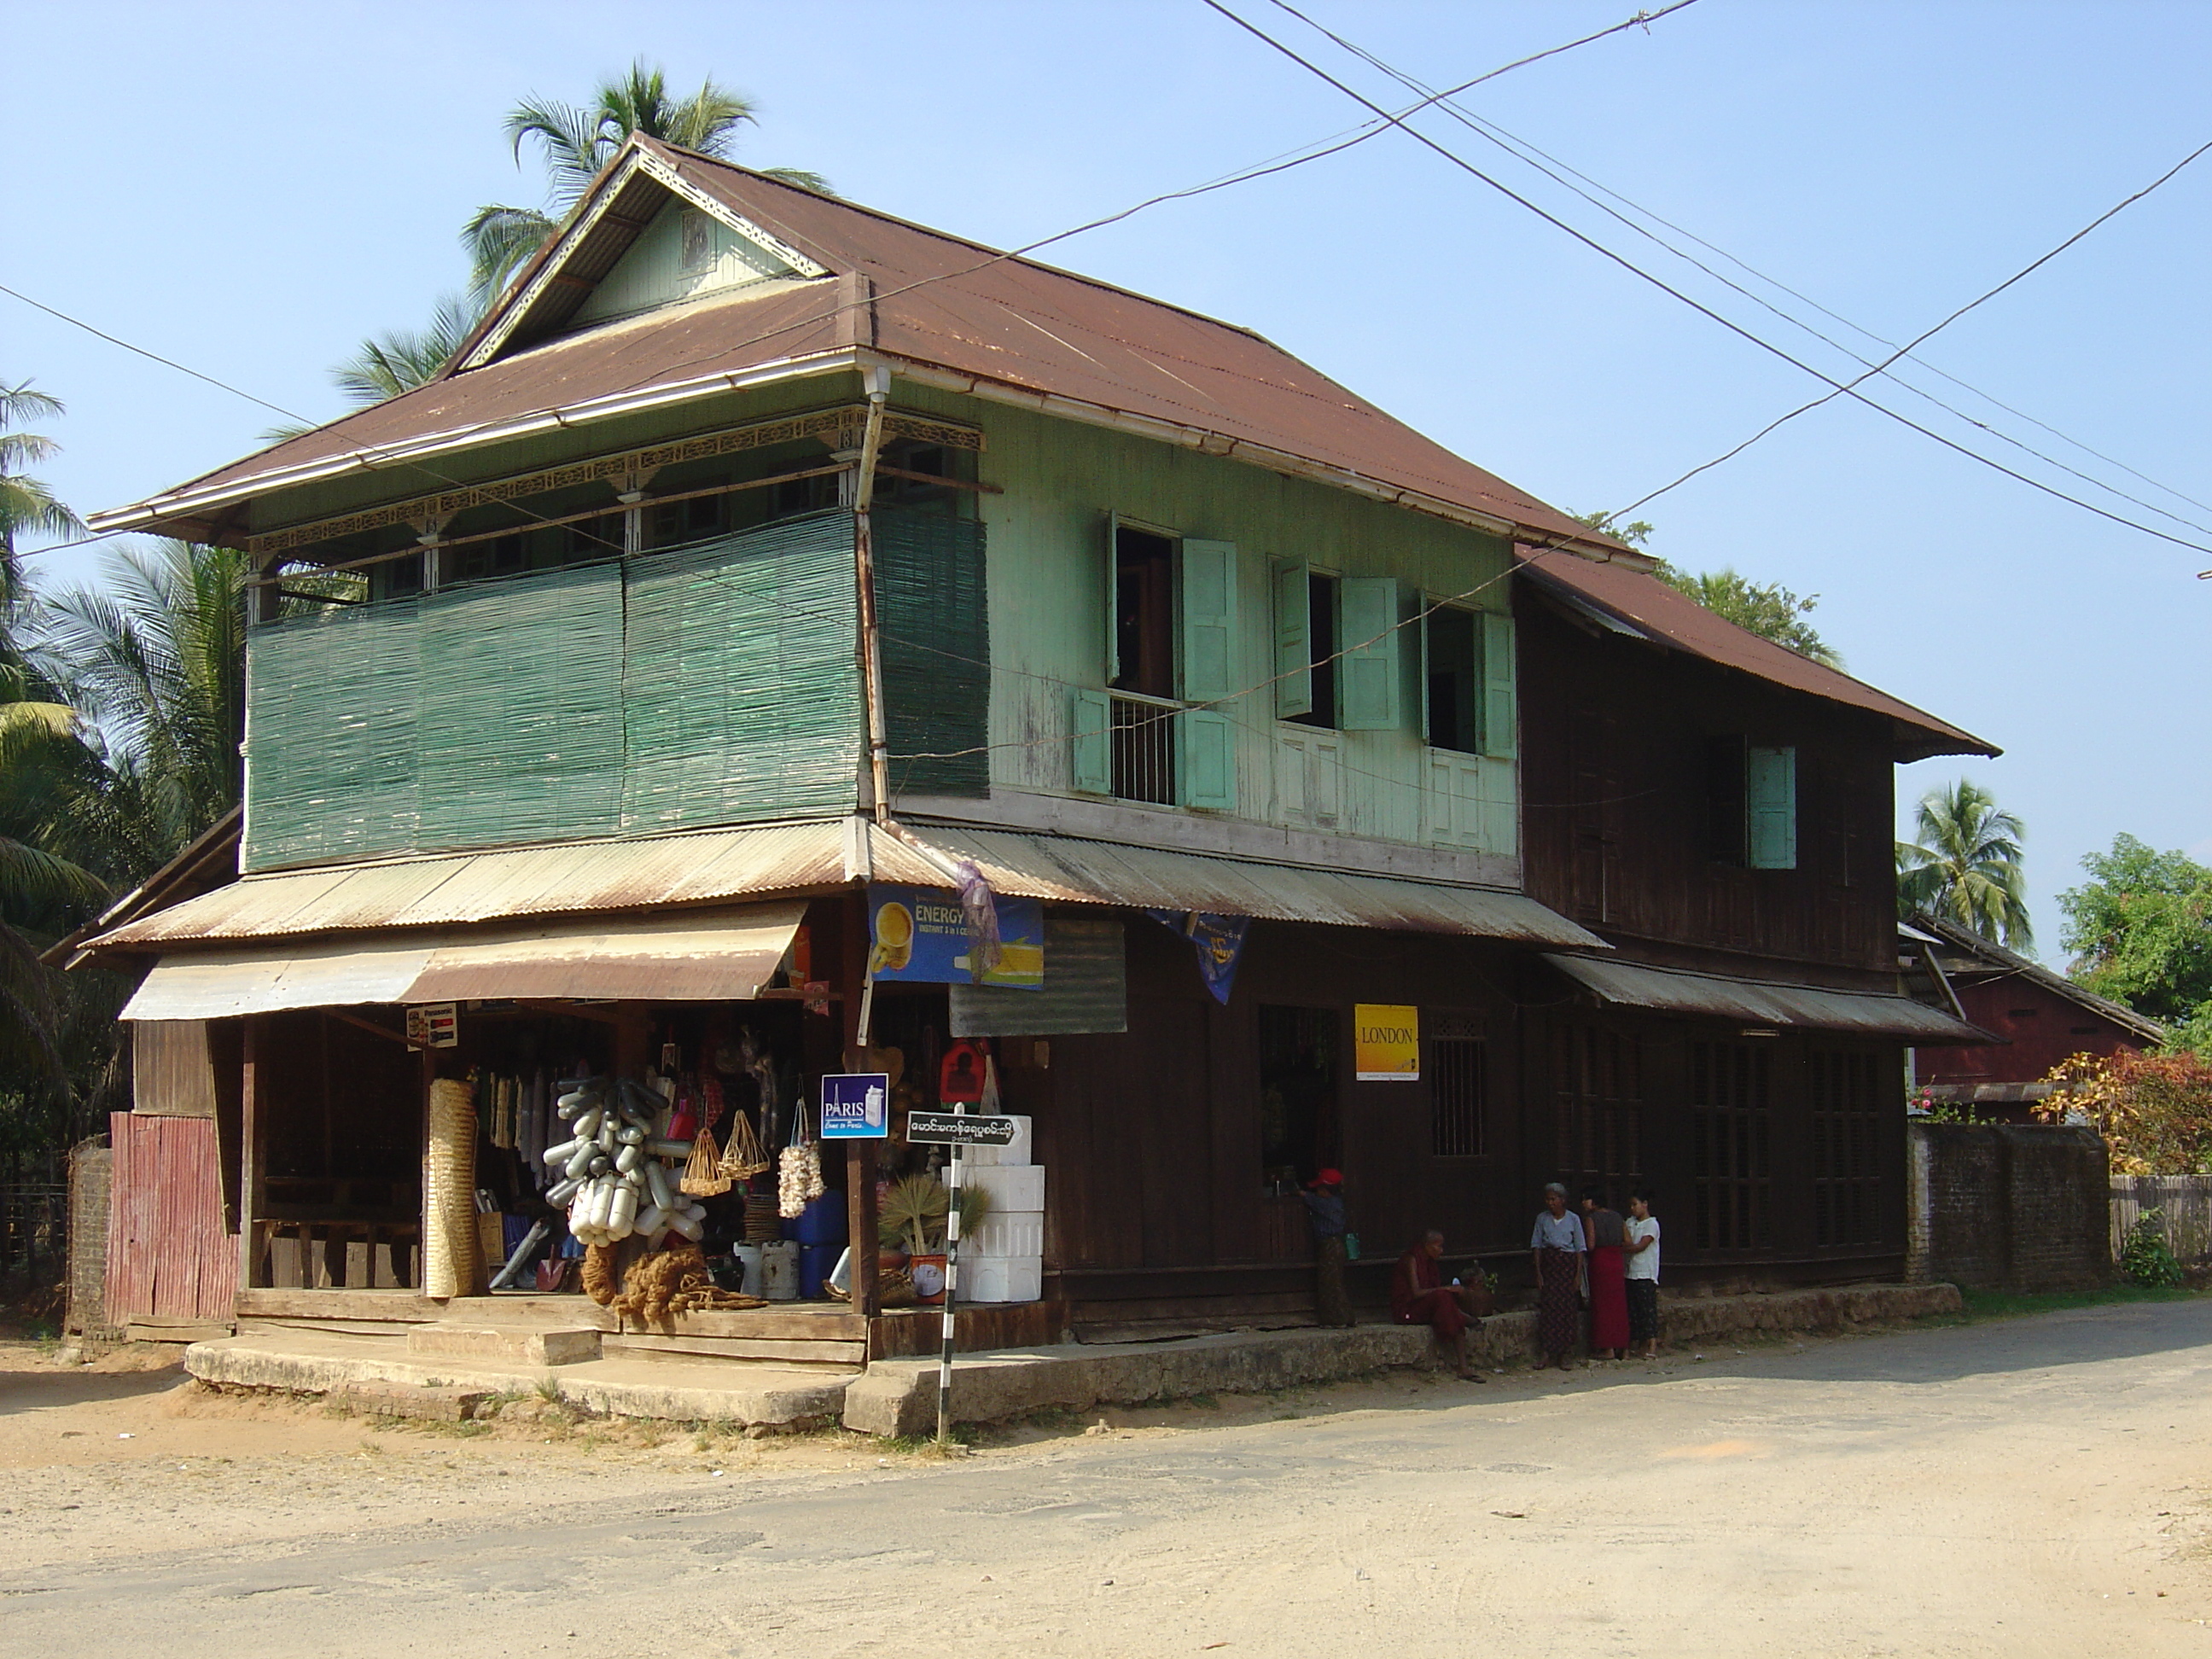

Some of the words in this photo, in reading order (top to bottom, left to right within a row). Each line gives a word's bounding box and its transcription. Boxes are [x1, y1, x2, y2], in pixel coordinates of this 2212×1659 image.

[916, 905, 964, 924] ENERGY
[1361, 1027, 1413, 1045] LONDON
[825, 1102, 864, 1117] PARIS
